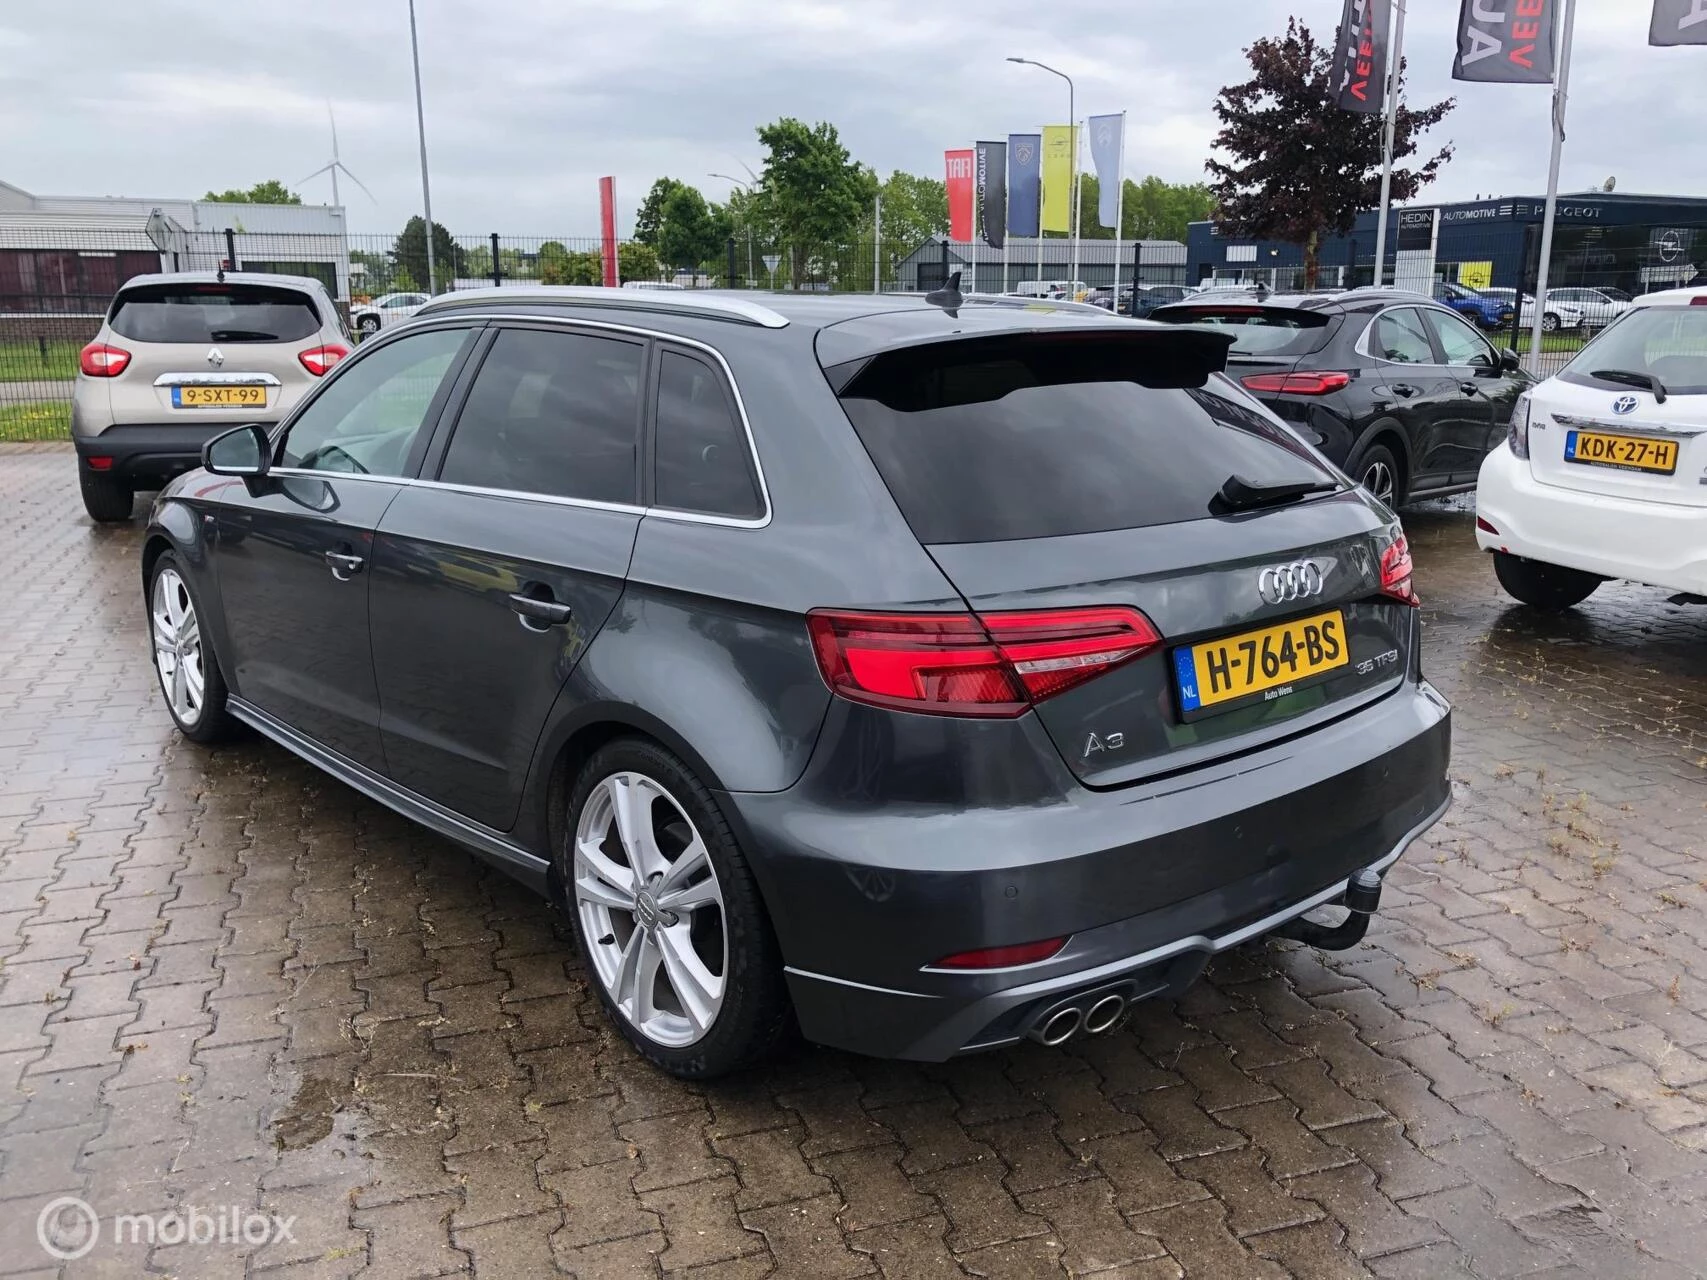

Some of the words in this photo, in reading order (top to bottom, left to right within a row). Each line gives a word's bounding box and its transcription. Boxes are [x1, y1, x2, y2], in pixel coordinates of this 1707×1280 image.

[1400, 212, 1432, 223] HEDIN
[1443, 208, 1496, 221] AUTOMOTIVE
[1534, 205, 1603, 218] PUGEOT
[187, 389, 259, 402] 9-SXT-99
[1580, 437, 1669, 466] KDK-27-H
[1206, 620, 1340, 694] H-764-BS
[1356, 659, 1374, 675] 35
[1374, 649, 1398, 667] TFSI
[1182, 684, 1197, 700] NL
[1264, 690, 1278, 701] Auto
[1084, 732, 1124, 757] A3
